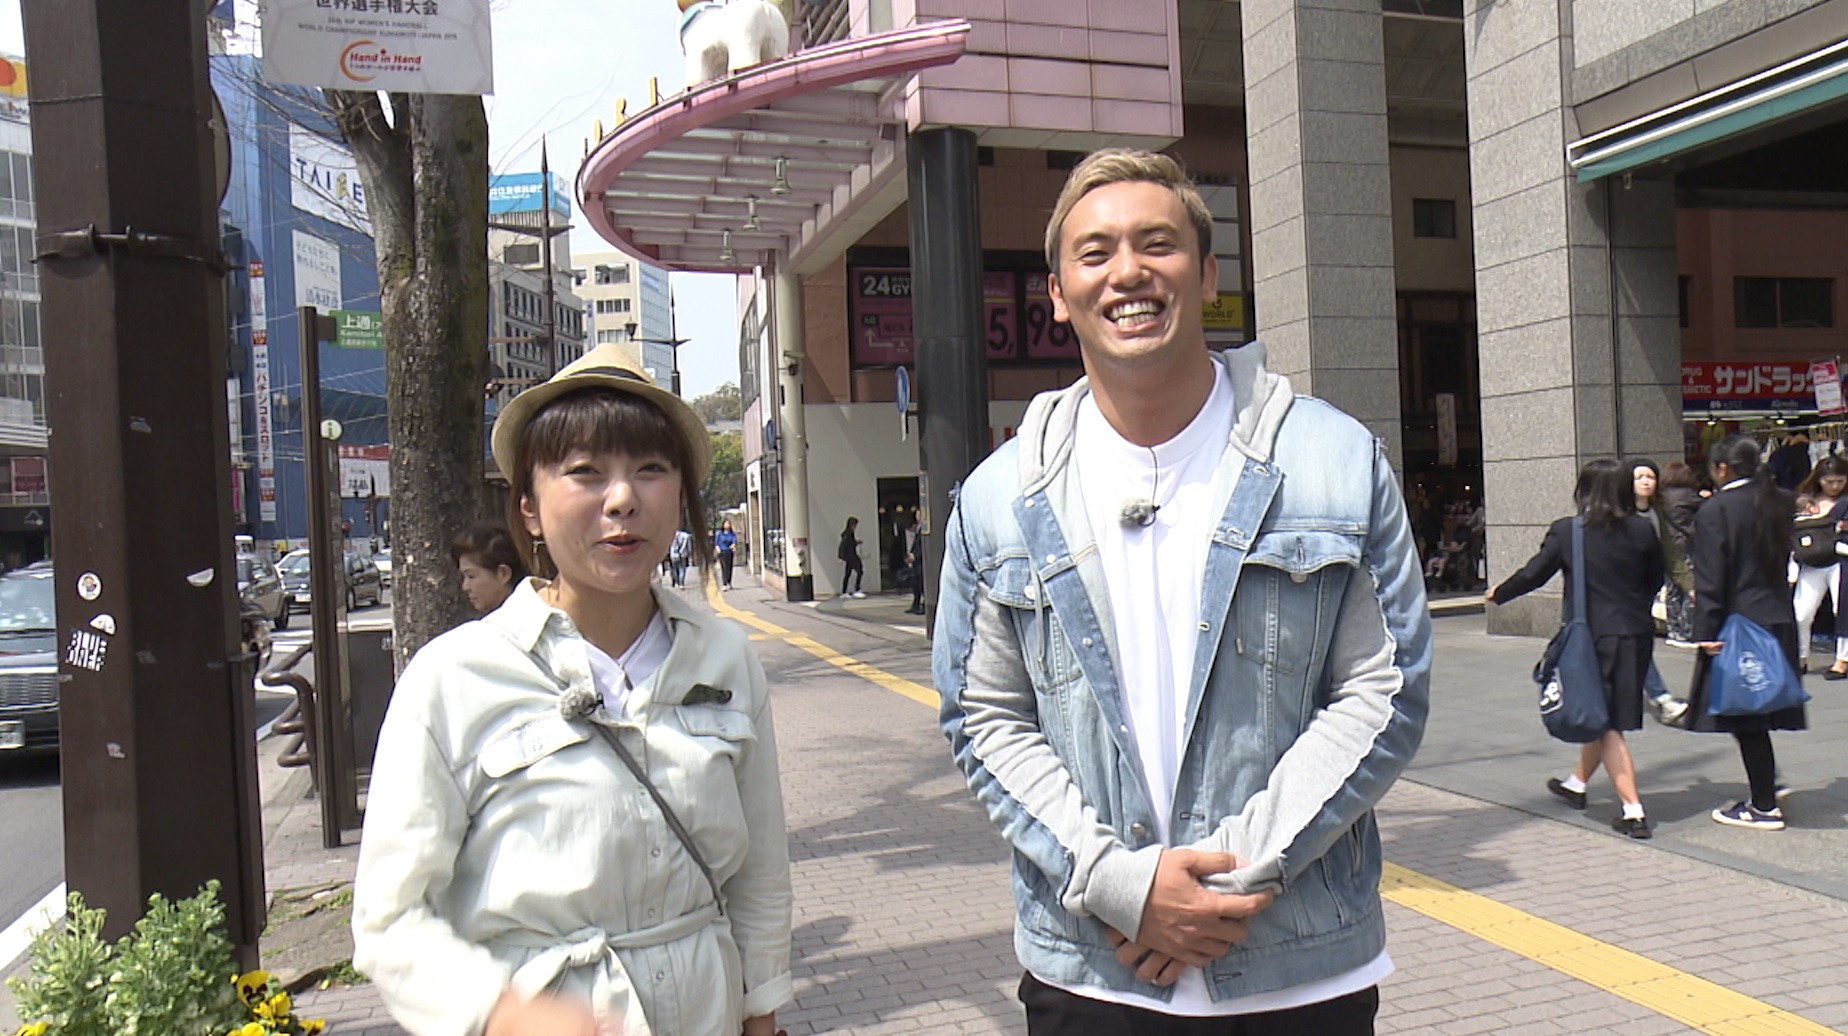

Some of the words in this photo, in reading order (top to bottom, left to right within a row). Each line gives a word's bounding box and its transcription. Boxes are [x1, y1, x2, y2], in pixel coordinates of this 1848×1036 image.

[350, 52, 378, 62] Hand
[381, 48, 391, 63] in
[393, 55, 422, 65] Hand
[863, 275, 891, 295] 24
